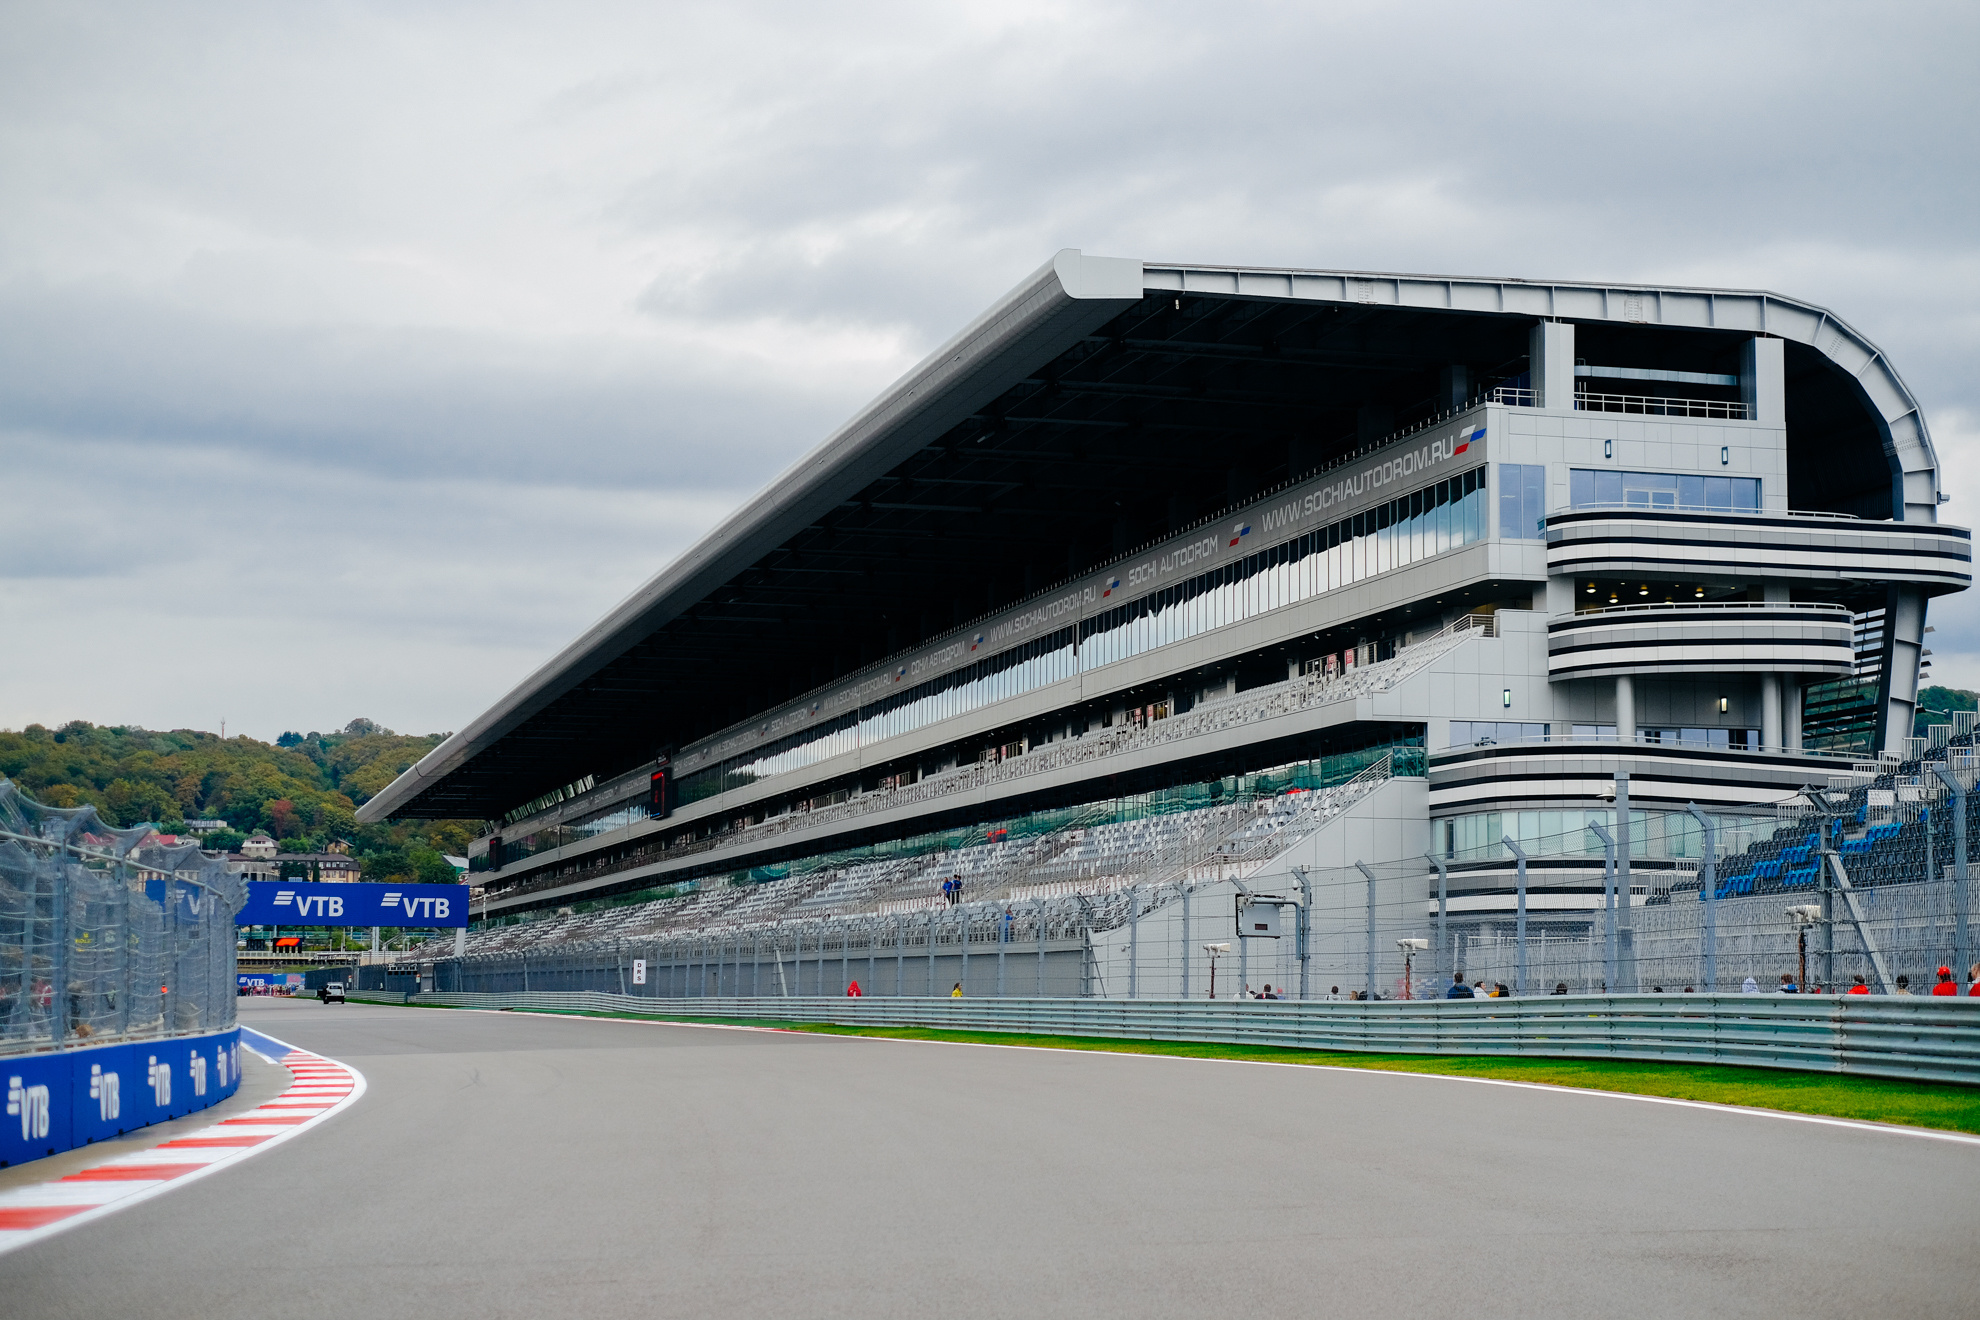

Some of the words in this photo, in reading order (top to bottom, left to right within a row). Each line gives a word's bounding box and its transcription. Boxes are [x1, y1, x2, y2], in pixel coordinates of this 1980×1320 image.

[1261, 434, 1455, 533] WWW.SOCHIAUTODROM.RU
[1128, 559, 1157, 587] SOCHI
[1159, 534, 1219, 574] AUTODROM
[990, 584, 1097, 643] WWW.SOCHIAUTODROM.RU
[911, 655, 929, 676] СОЧИ
[929, 640, 965, 669] АВТОДРОМ
[296, 895, 344, 918] VTB
[403, 897, 450, 919] VTB
[247, 978, 265, 987] VTB
[100, 1071, 120, 1122] VTB
[154, 1062, 172, 1108] VTB
[20, 1083, 50, 1142] VTB
